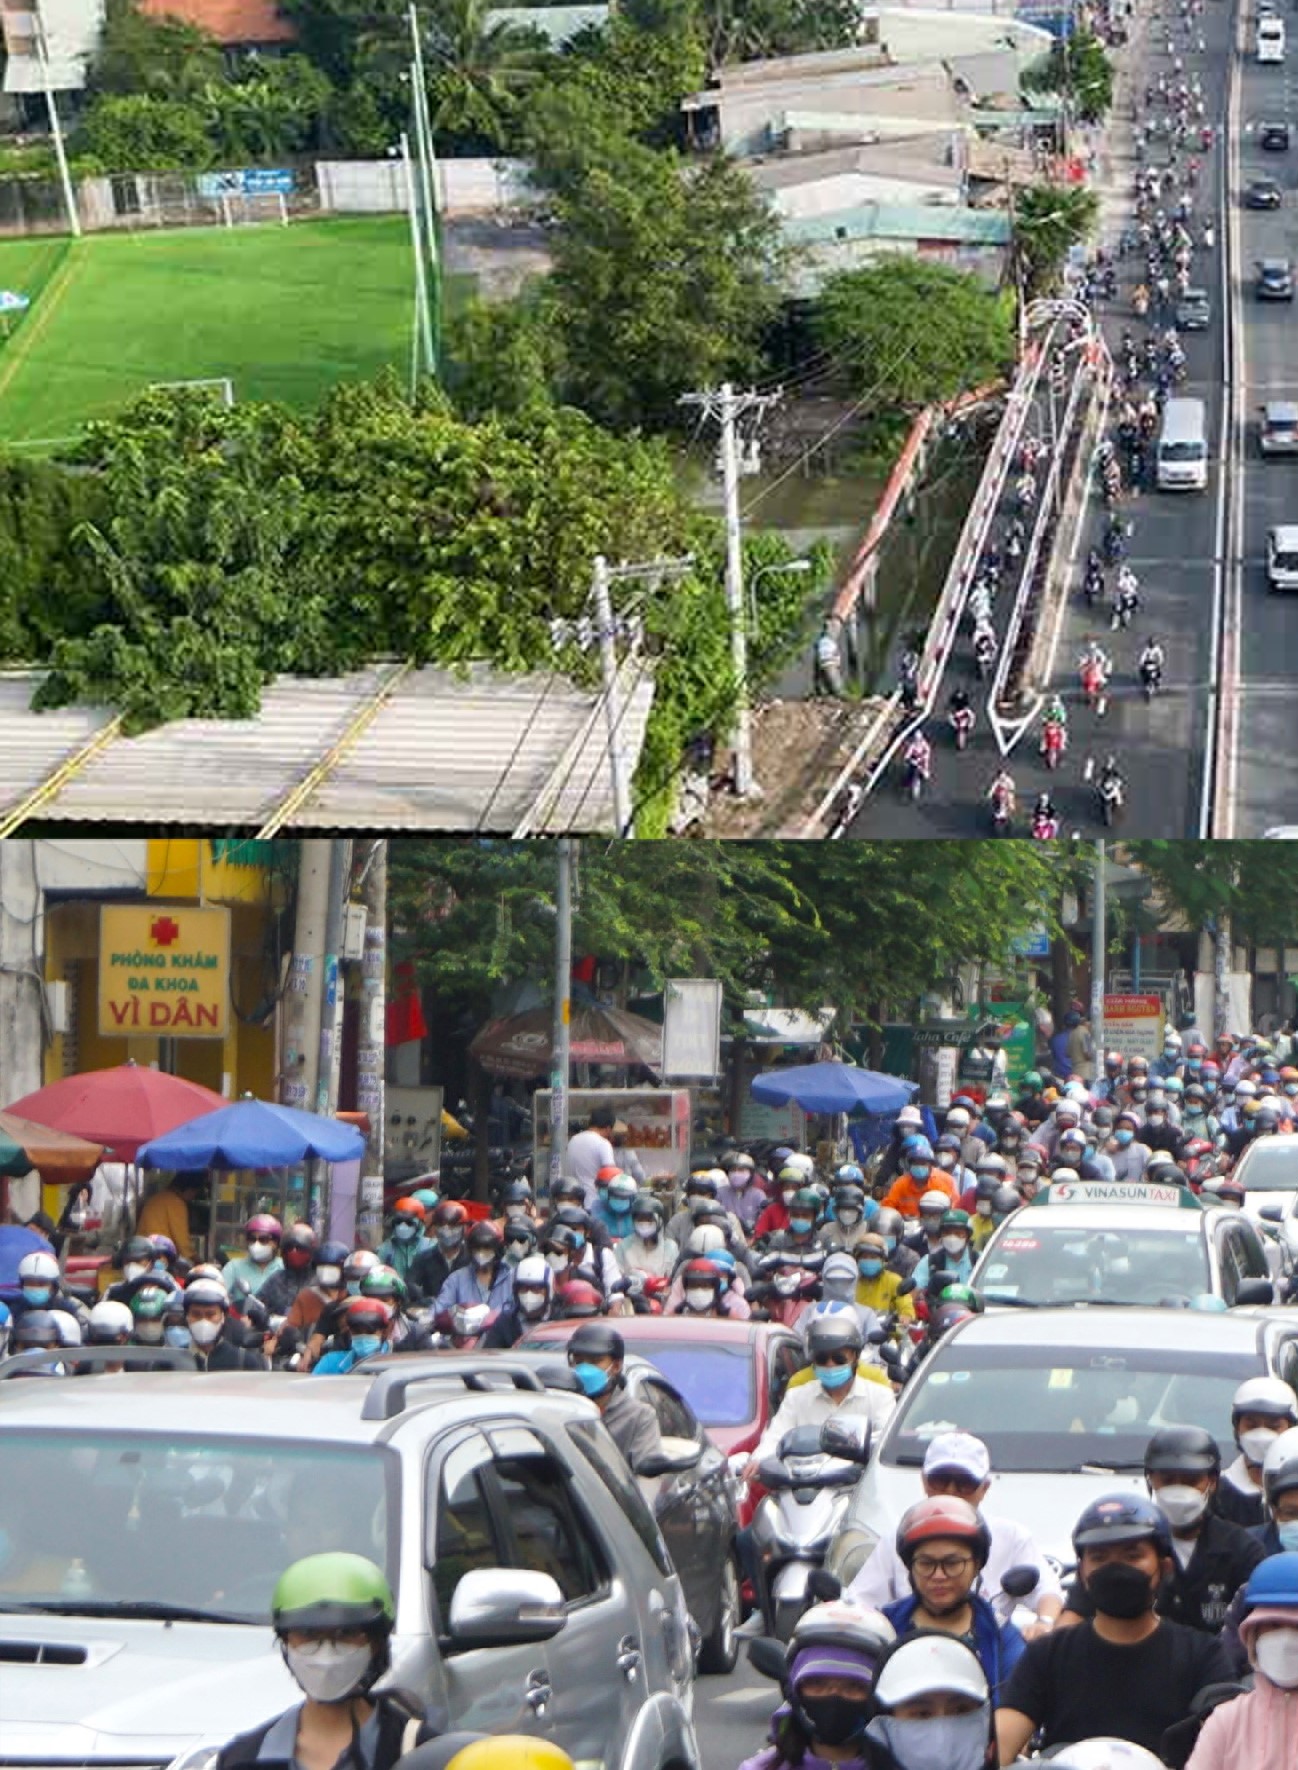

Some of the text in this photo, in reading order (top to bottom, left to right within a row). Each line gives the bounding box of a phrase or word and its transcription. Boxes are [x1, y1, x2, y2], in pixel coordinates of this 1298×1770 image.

[110, 949, 217, 968] PHÒNG KHÁM
[127, 977, 199, 991] ĐA KHOA
[109, 994, 218, 1027] VÌ DÂN
[1085, 1187, 1176, 1201] VINASUN TAXI
